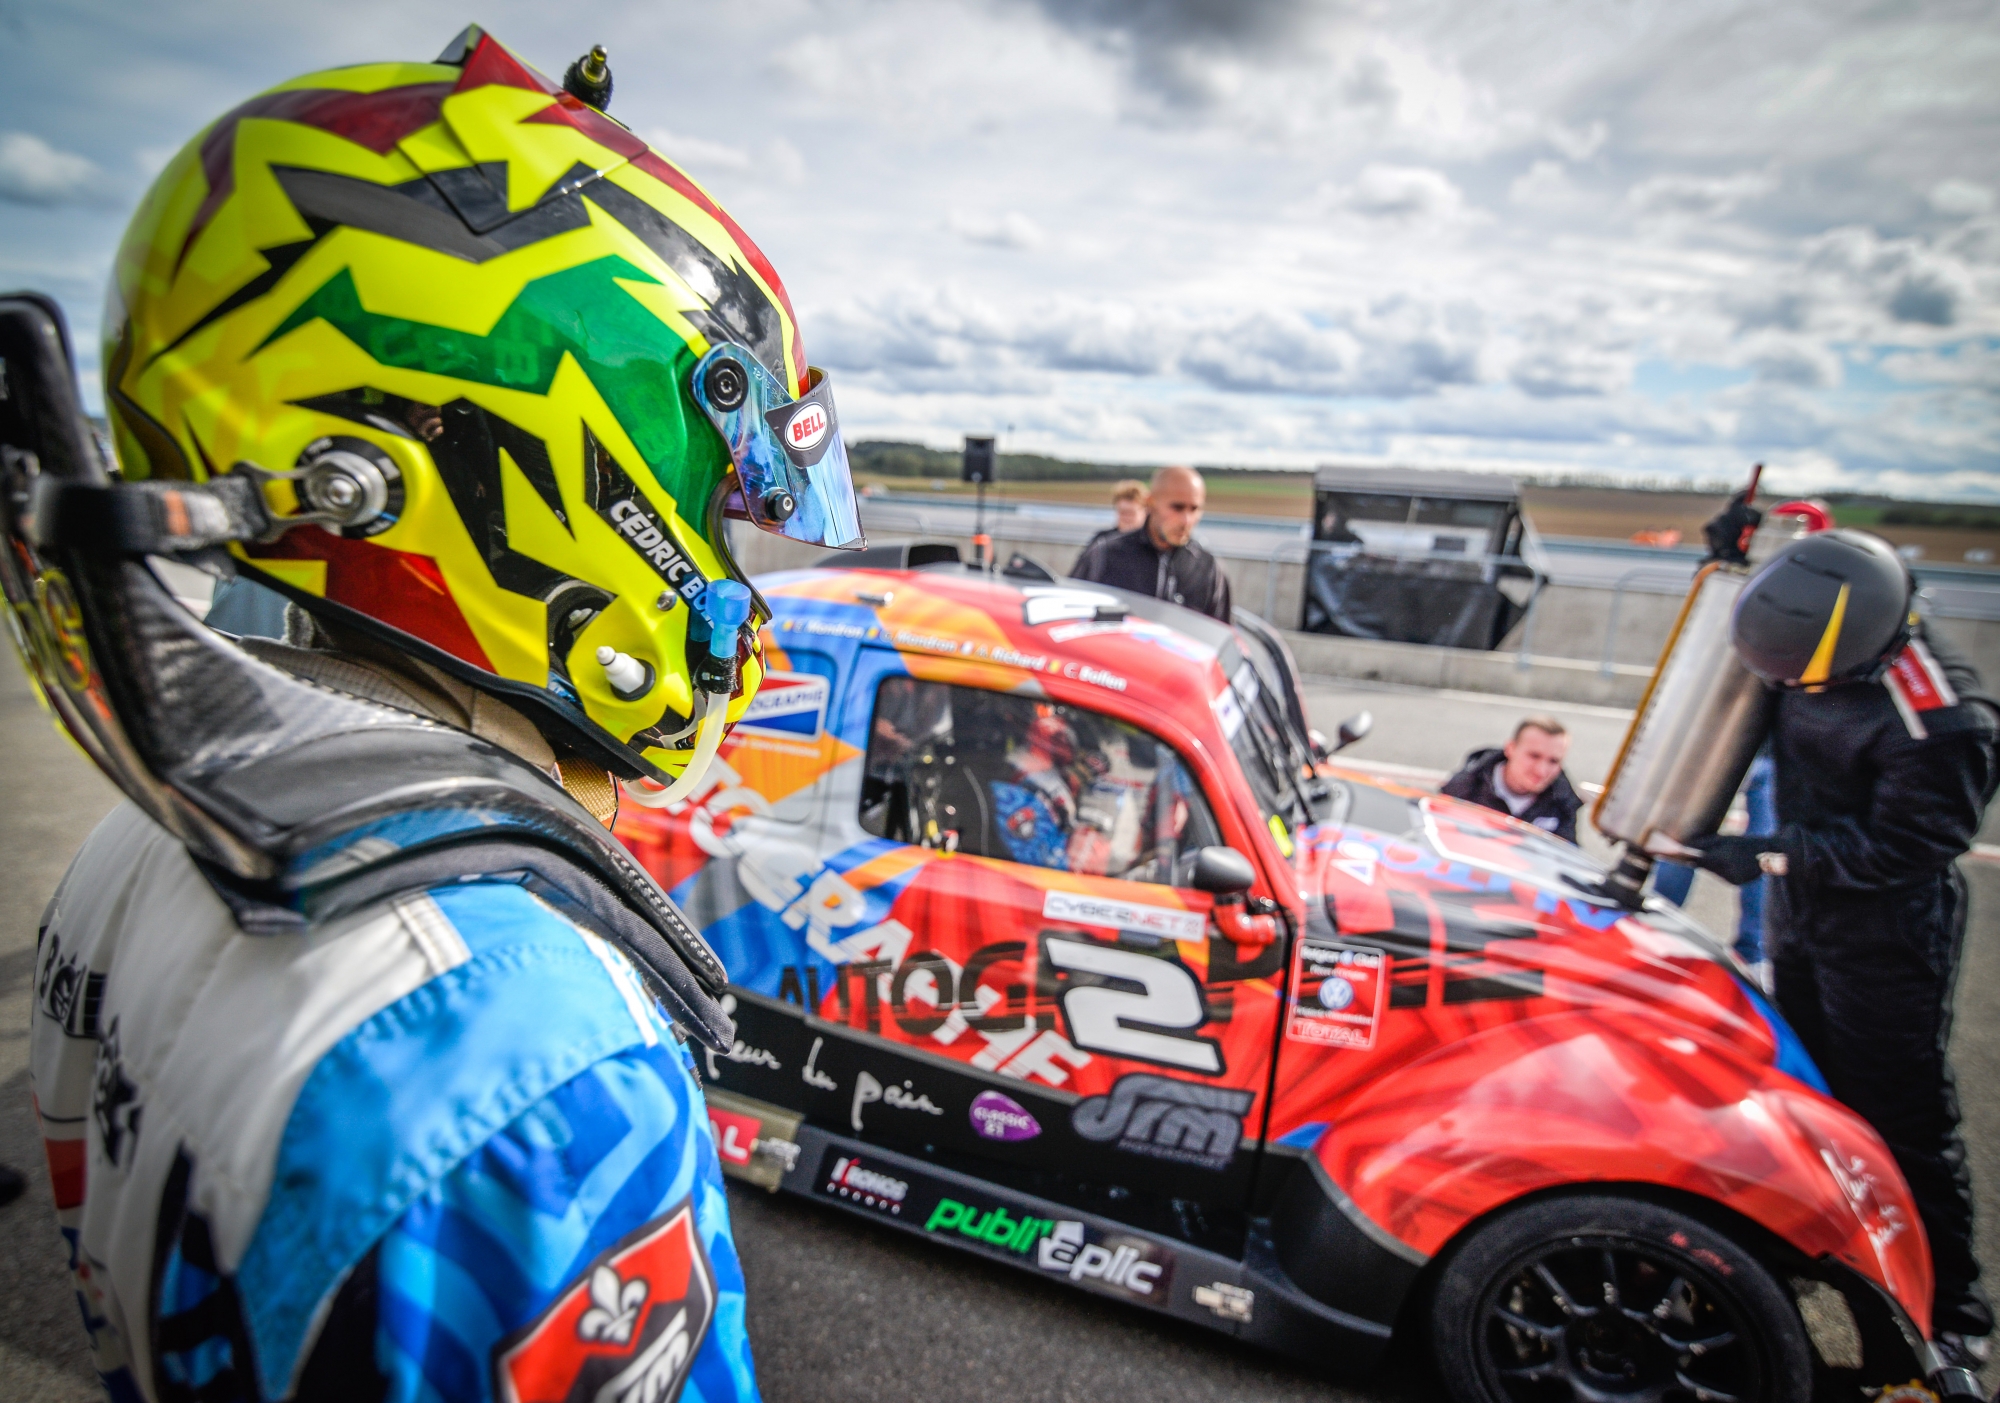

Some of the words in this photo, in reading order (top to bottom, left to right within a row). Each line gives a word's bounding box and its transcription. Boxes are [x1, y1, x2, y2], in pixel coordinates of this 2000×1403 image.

[792, 413, 825, 442] BELL
[610, 500, 692, 582] CÉDRIC
[806, 620, 865, 639] Mondron
[896, 630, 958, 653] Mondron
[990, 645, 1048, 671] Richard
[747, 688, 823, 713] OGRAPHE
[1042, 936, 1228, 1074] 2
